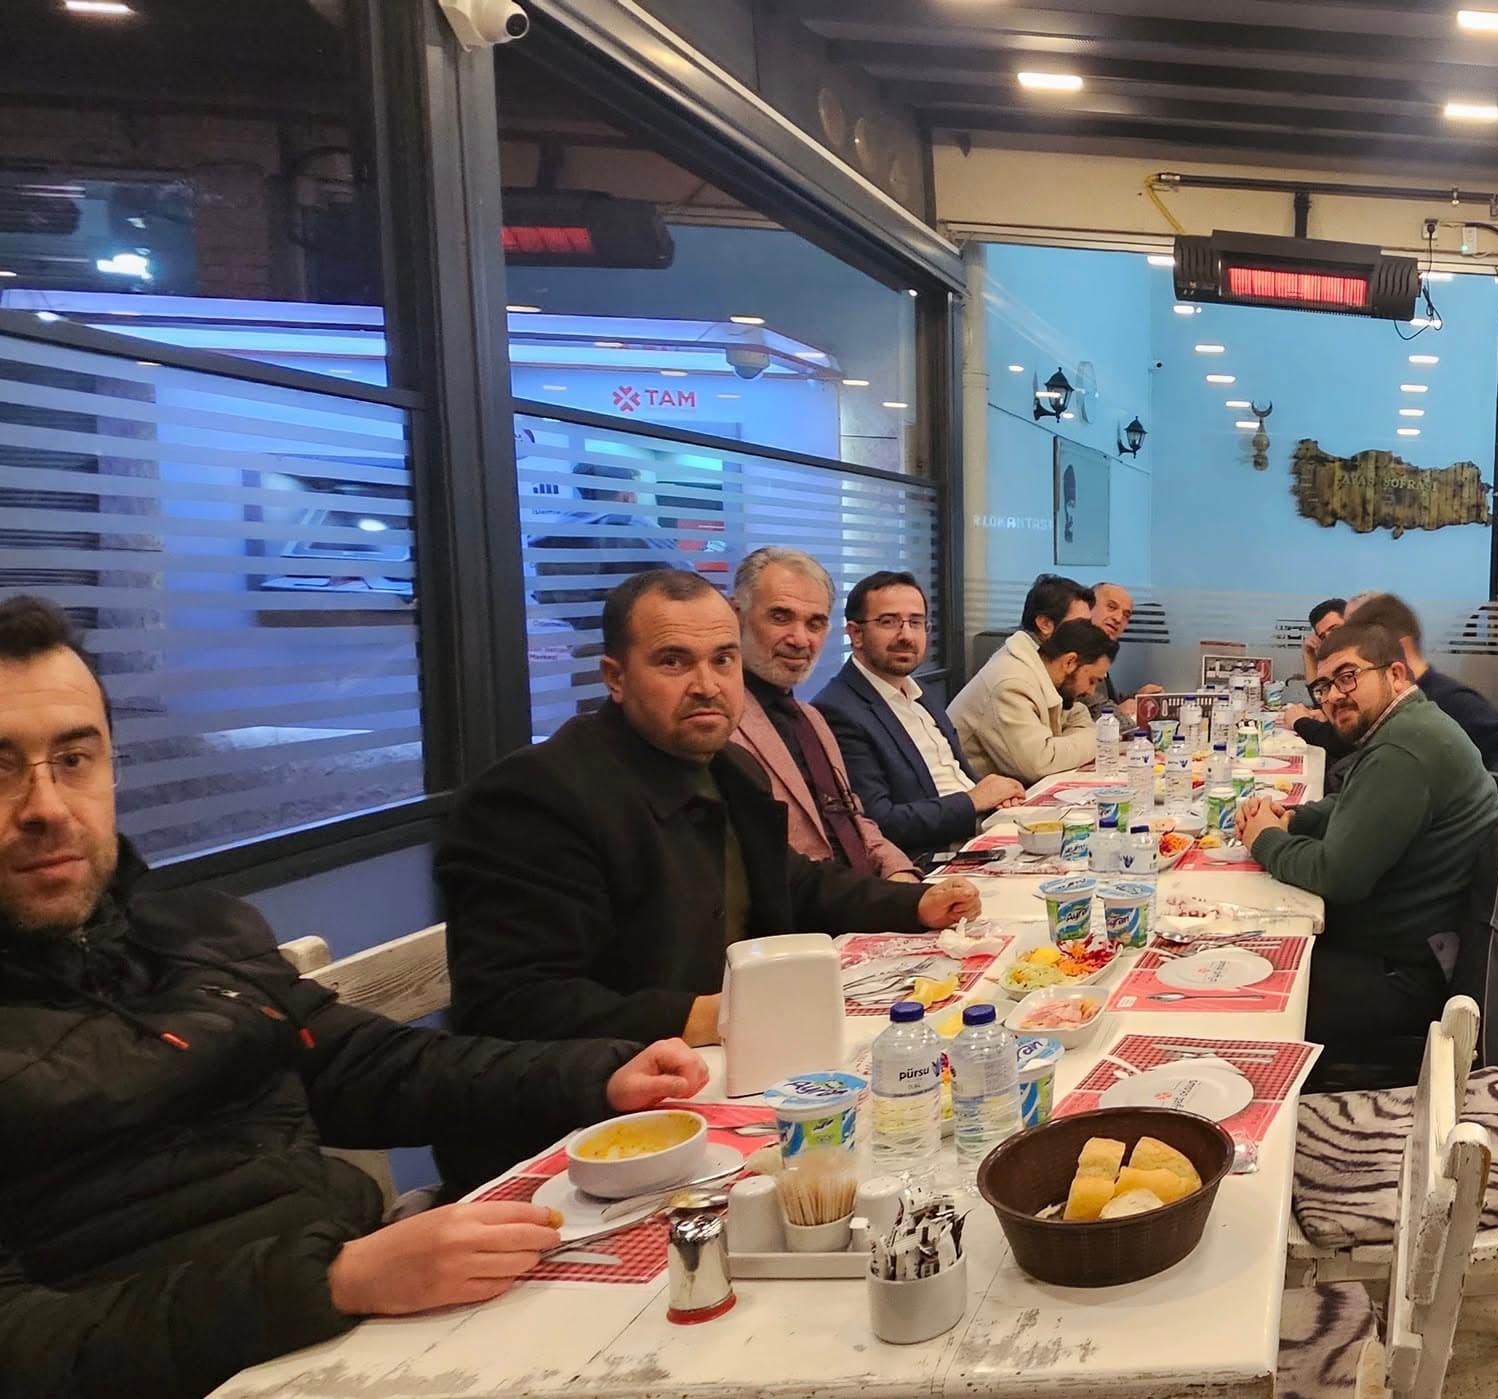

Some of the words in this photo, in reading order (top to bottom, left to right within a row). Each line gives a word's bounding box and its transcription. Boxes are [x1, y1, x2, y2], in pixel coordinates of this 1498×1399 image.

[644, 389, 696, 408] TAM
[899, 1067, 930, 1081] pürsu
[784, 1081, 849, 1097] Ayran
